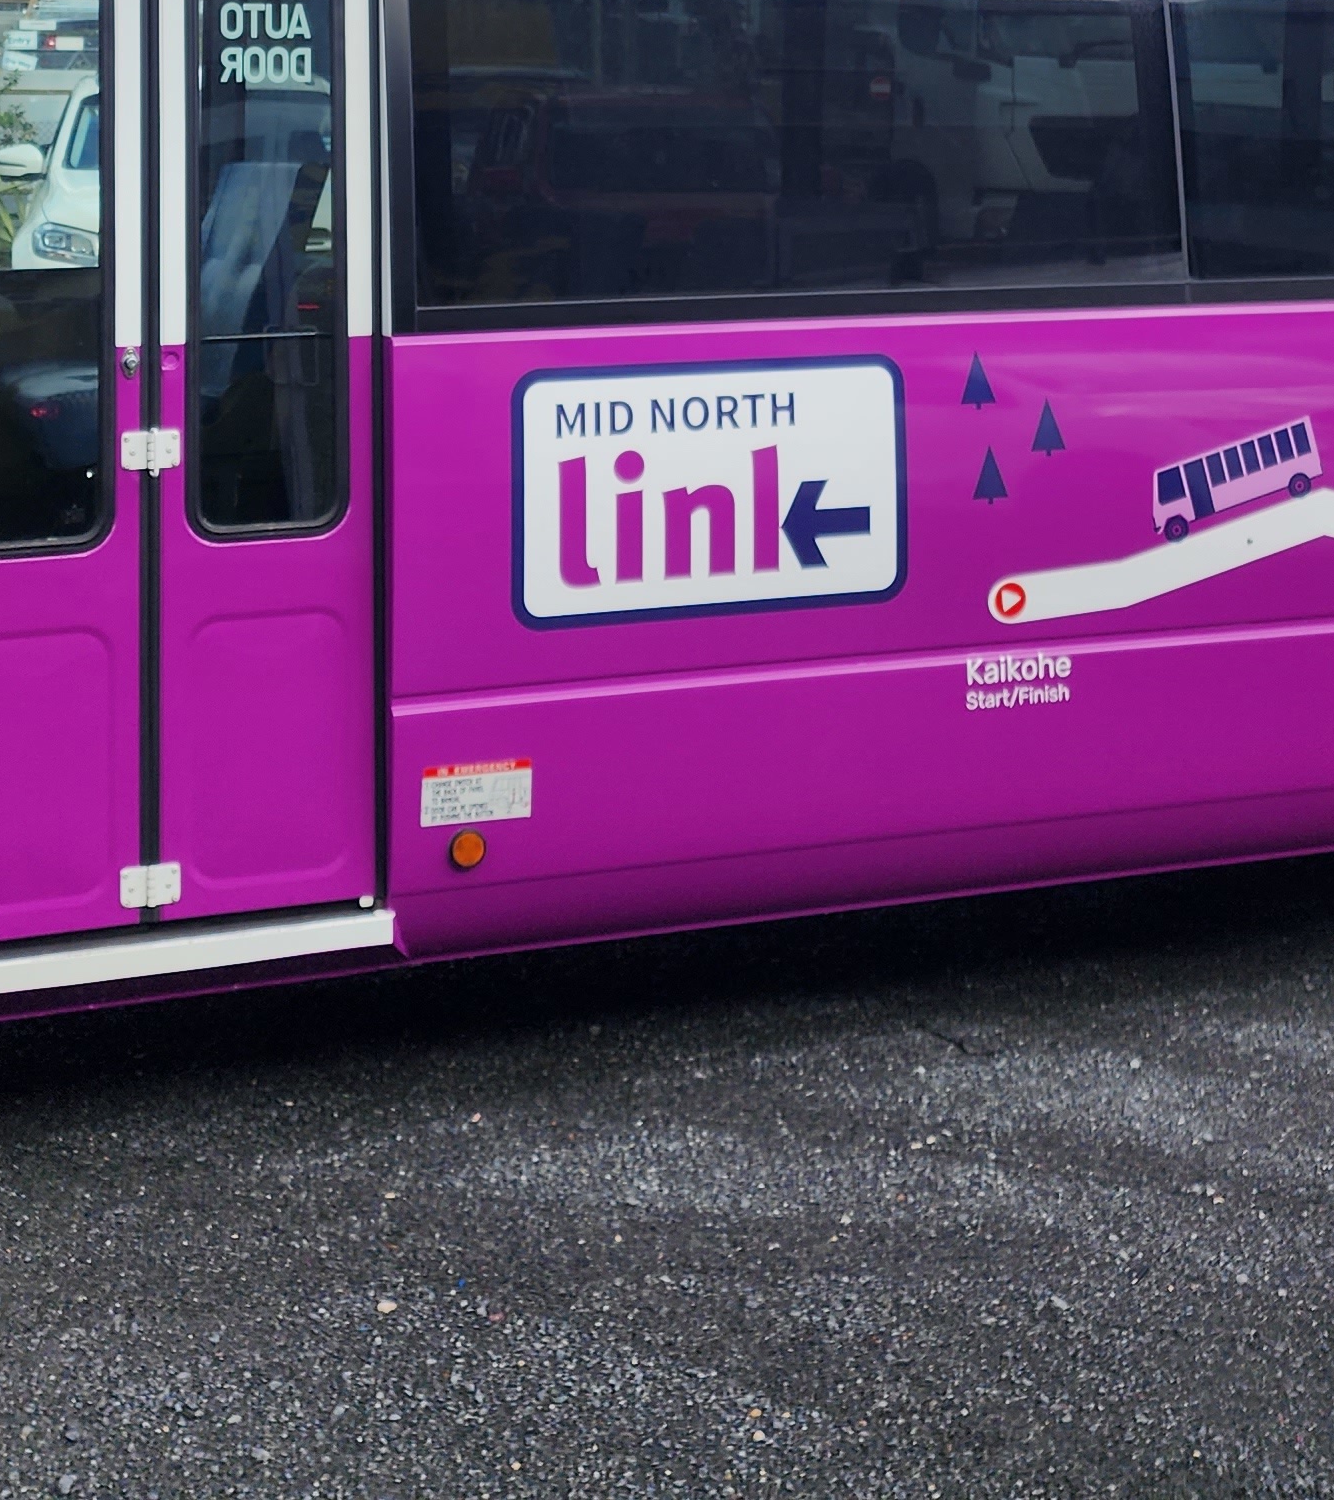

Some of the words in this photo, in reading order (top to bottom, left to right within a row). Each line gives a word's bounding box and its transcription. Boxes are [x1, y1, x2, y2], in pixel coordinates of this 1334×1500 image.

[555, 400, 634, 439] MID
[650, 391, 796, 434] NORTH
[558, 444, 829, 590] link
[966, 652, 1072, 686] Kaikohe
[965, 683, 1070, 711] Start/Finish
